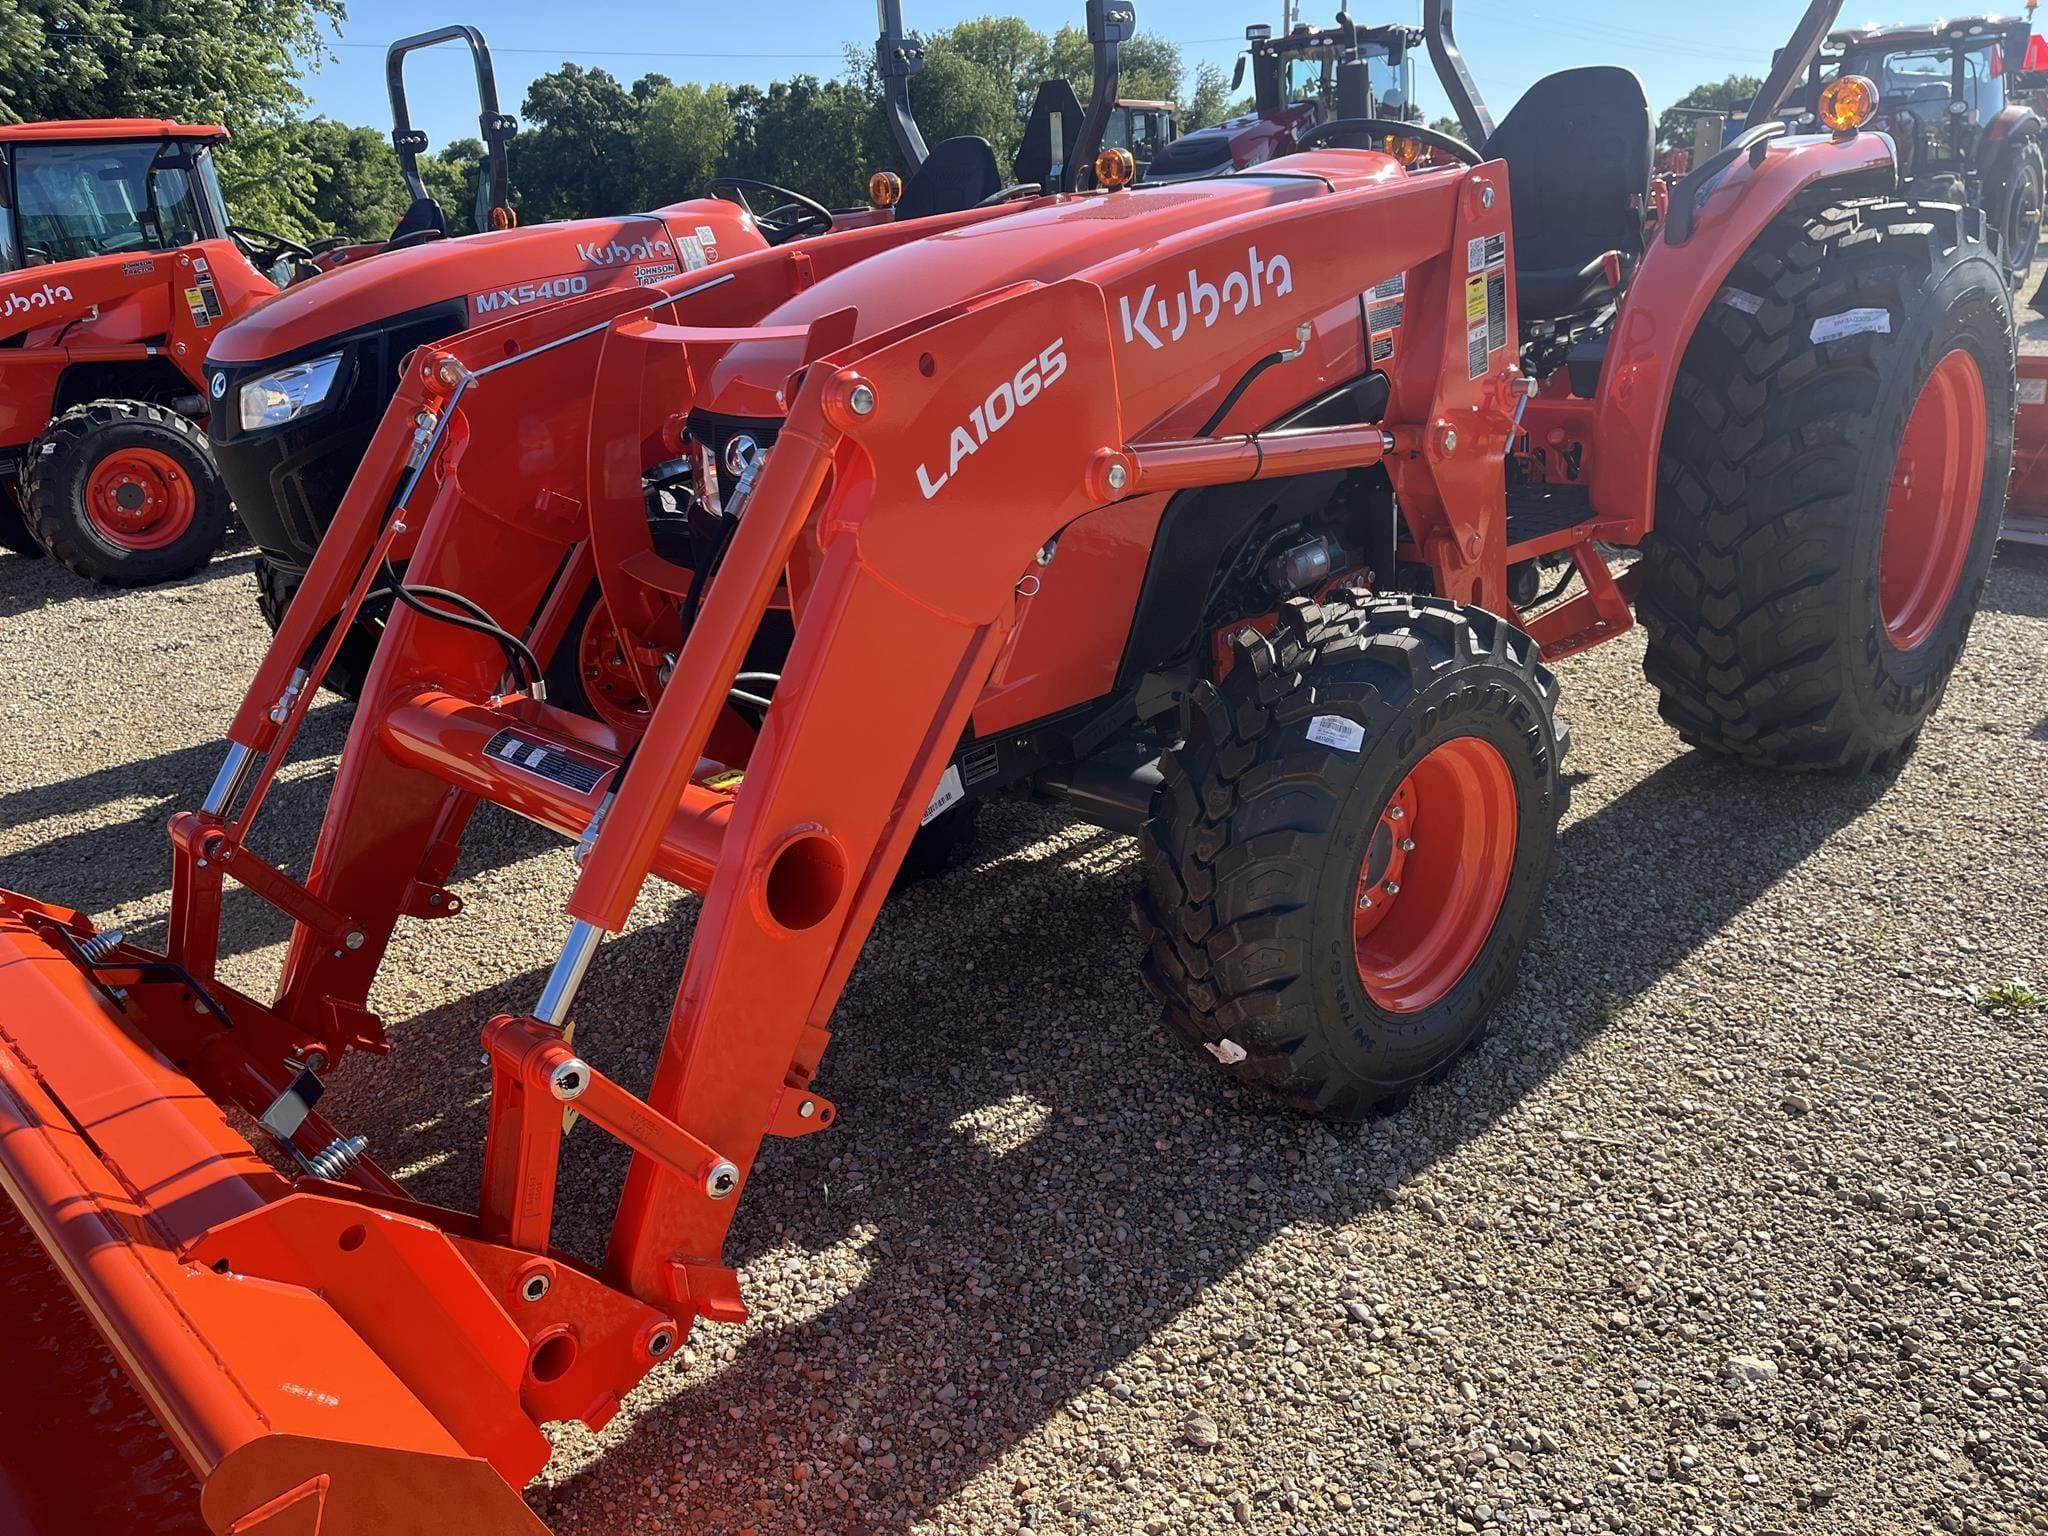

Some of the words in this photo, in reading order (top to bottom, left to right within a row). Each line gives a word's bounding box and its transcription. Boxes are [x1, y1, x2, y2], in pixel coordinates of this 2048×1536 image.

[576, 235, 672, 265] Kubota
[634, 264, 674, 276] JOHNSON
[0, 284, 73, 317] ubota
[477, 275, 588, 313] MX5400
[1119, 246, 1293, 350] Kubota
[916, 337, 1067, 499] LA1065
